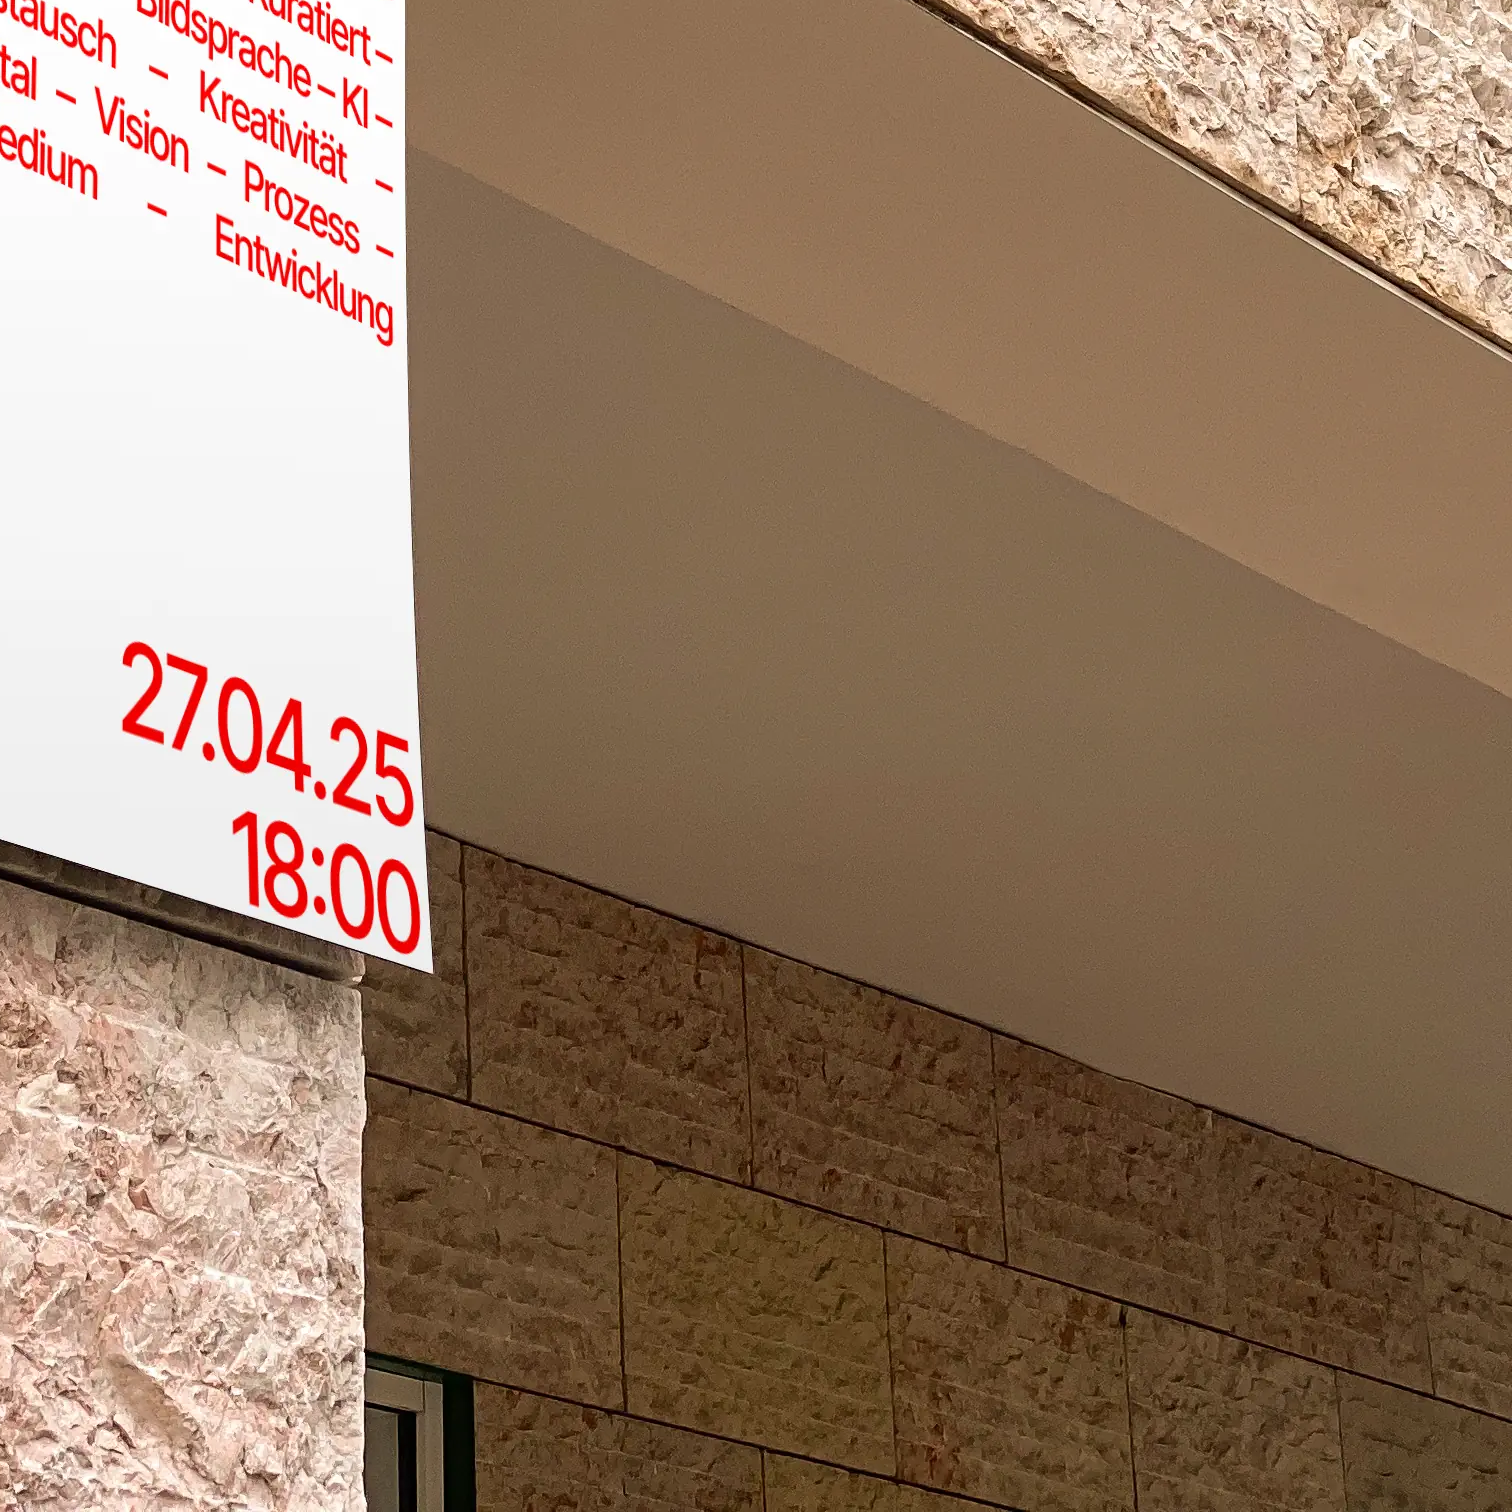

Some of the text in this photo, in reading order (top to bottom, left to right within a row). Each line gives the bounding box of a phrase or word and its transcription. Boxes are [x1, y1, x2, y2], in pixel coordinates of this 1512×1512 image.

[95, 86, 189, 173] Vision
[245, 160, 360, 254] Prozess
[200, 70, 347, 184] Kreativität
[343, 77, 368, 128] KI
[216, 214, 393, 346] Entwicklung
[122, 642, 414, 827] 27.04.25
[232, 811, 420, 954] 18:00
